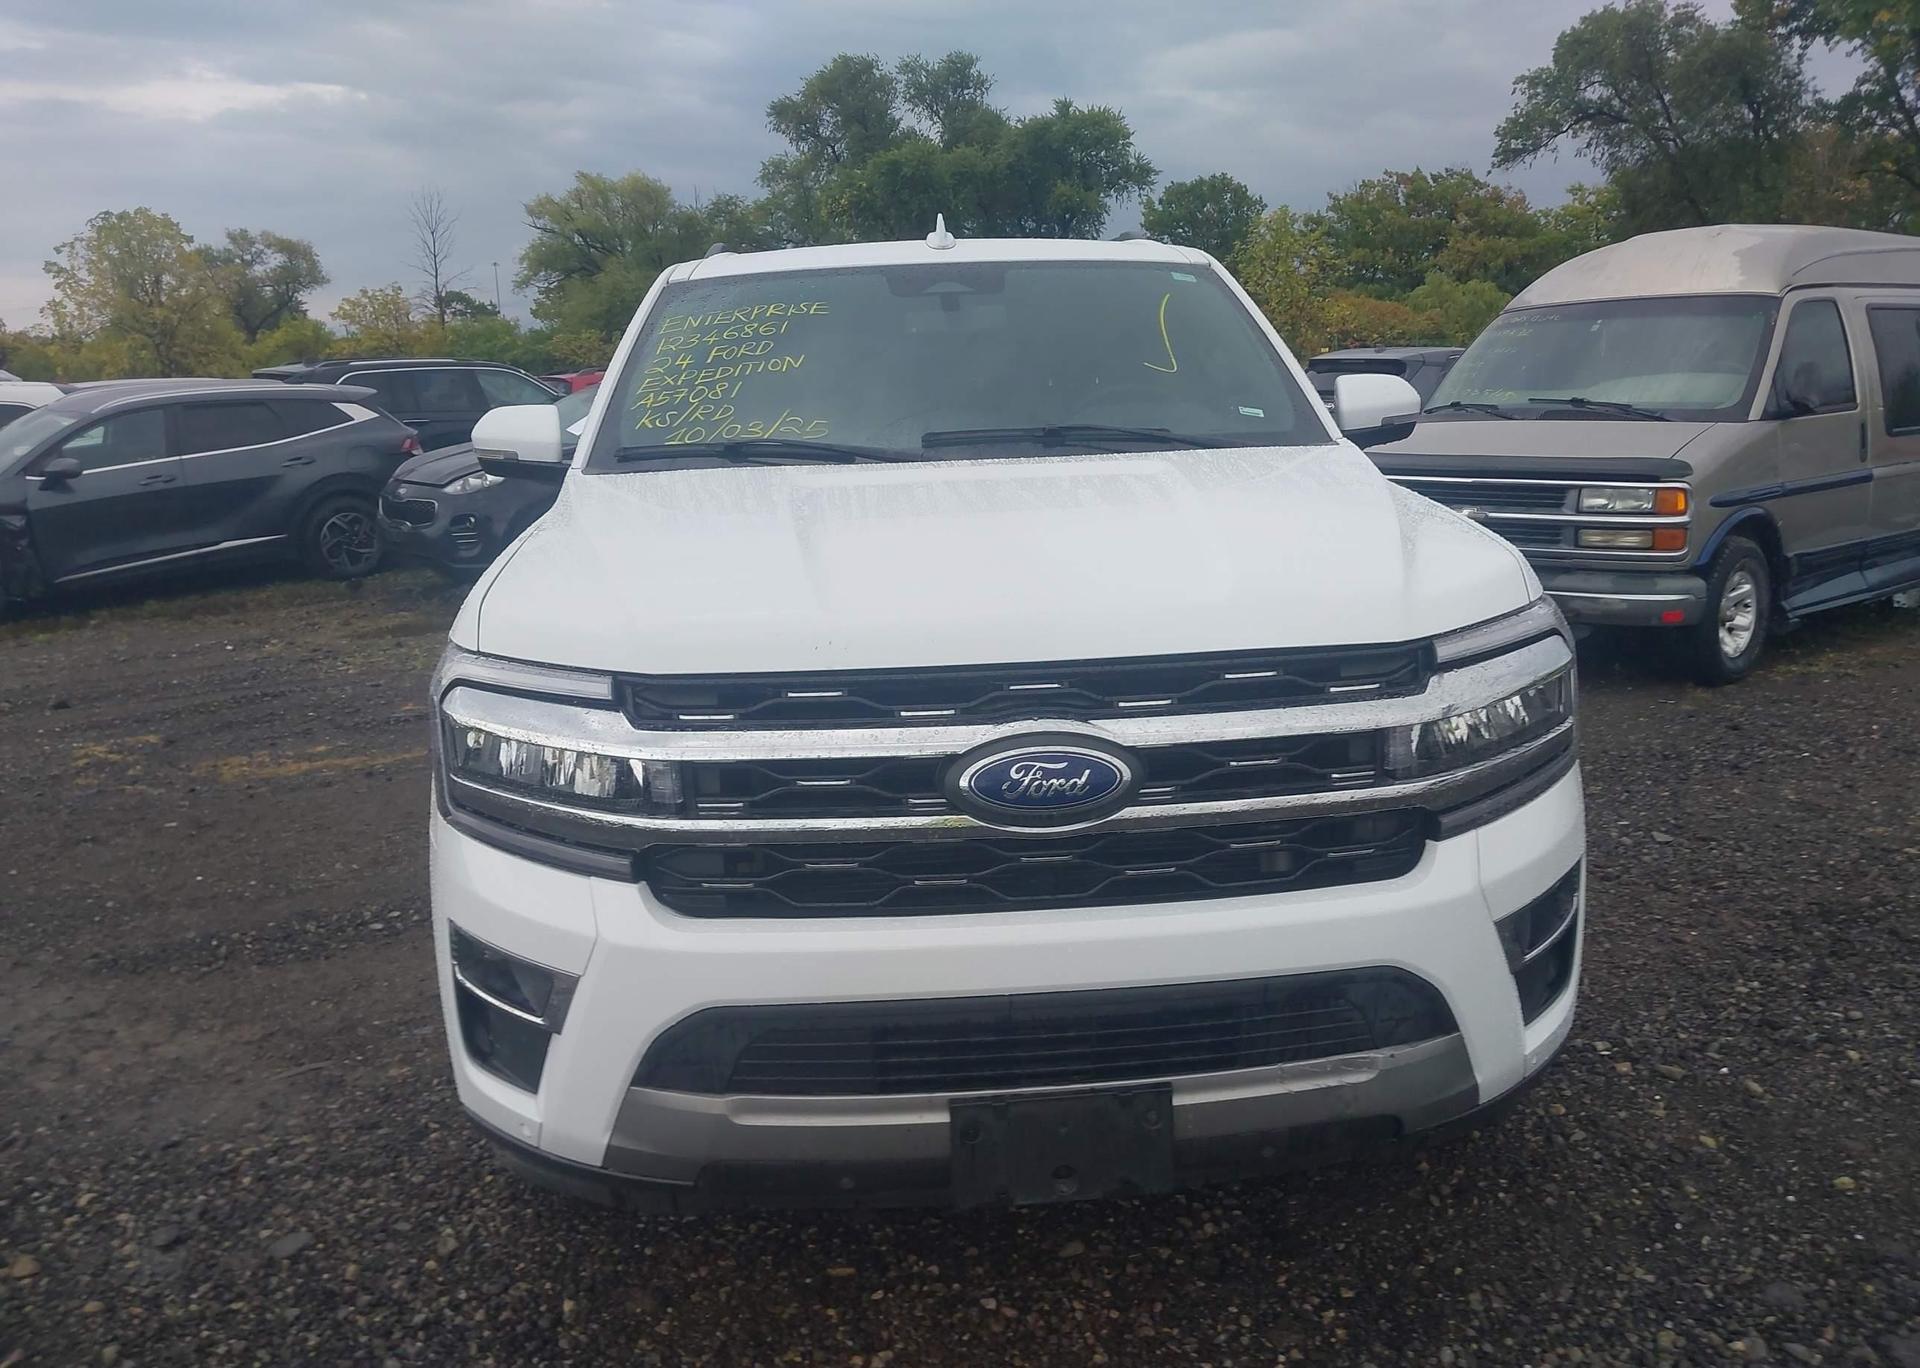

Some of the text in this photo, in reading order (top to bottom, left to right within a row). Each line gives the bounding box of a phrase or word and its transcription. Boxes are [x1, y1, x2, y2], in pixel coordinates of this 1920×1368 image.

[659, 301, 831, 334] ENTERPRISE
[656, 321, 788, 354] 12346861
[636, 355, 805, 394] EXPEDITION
[644, 341, 774, 375] 24 FORD
[631, 381, 742, 410] A57081
[635, 403, 734, 430] KS/RD
[664, 409, 829, 445] 10/03/25
[1001, 761, 1090, 797] Ford
